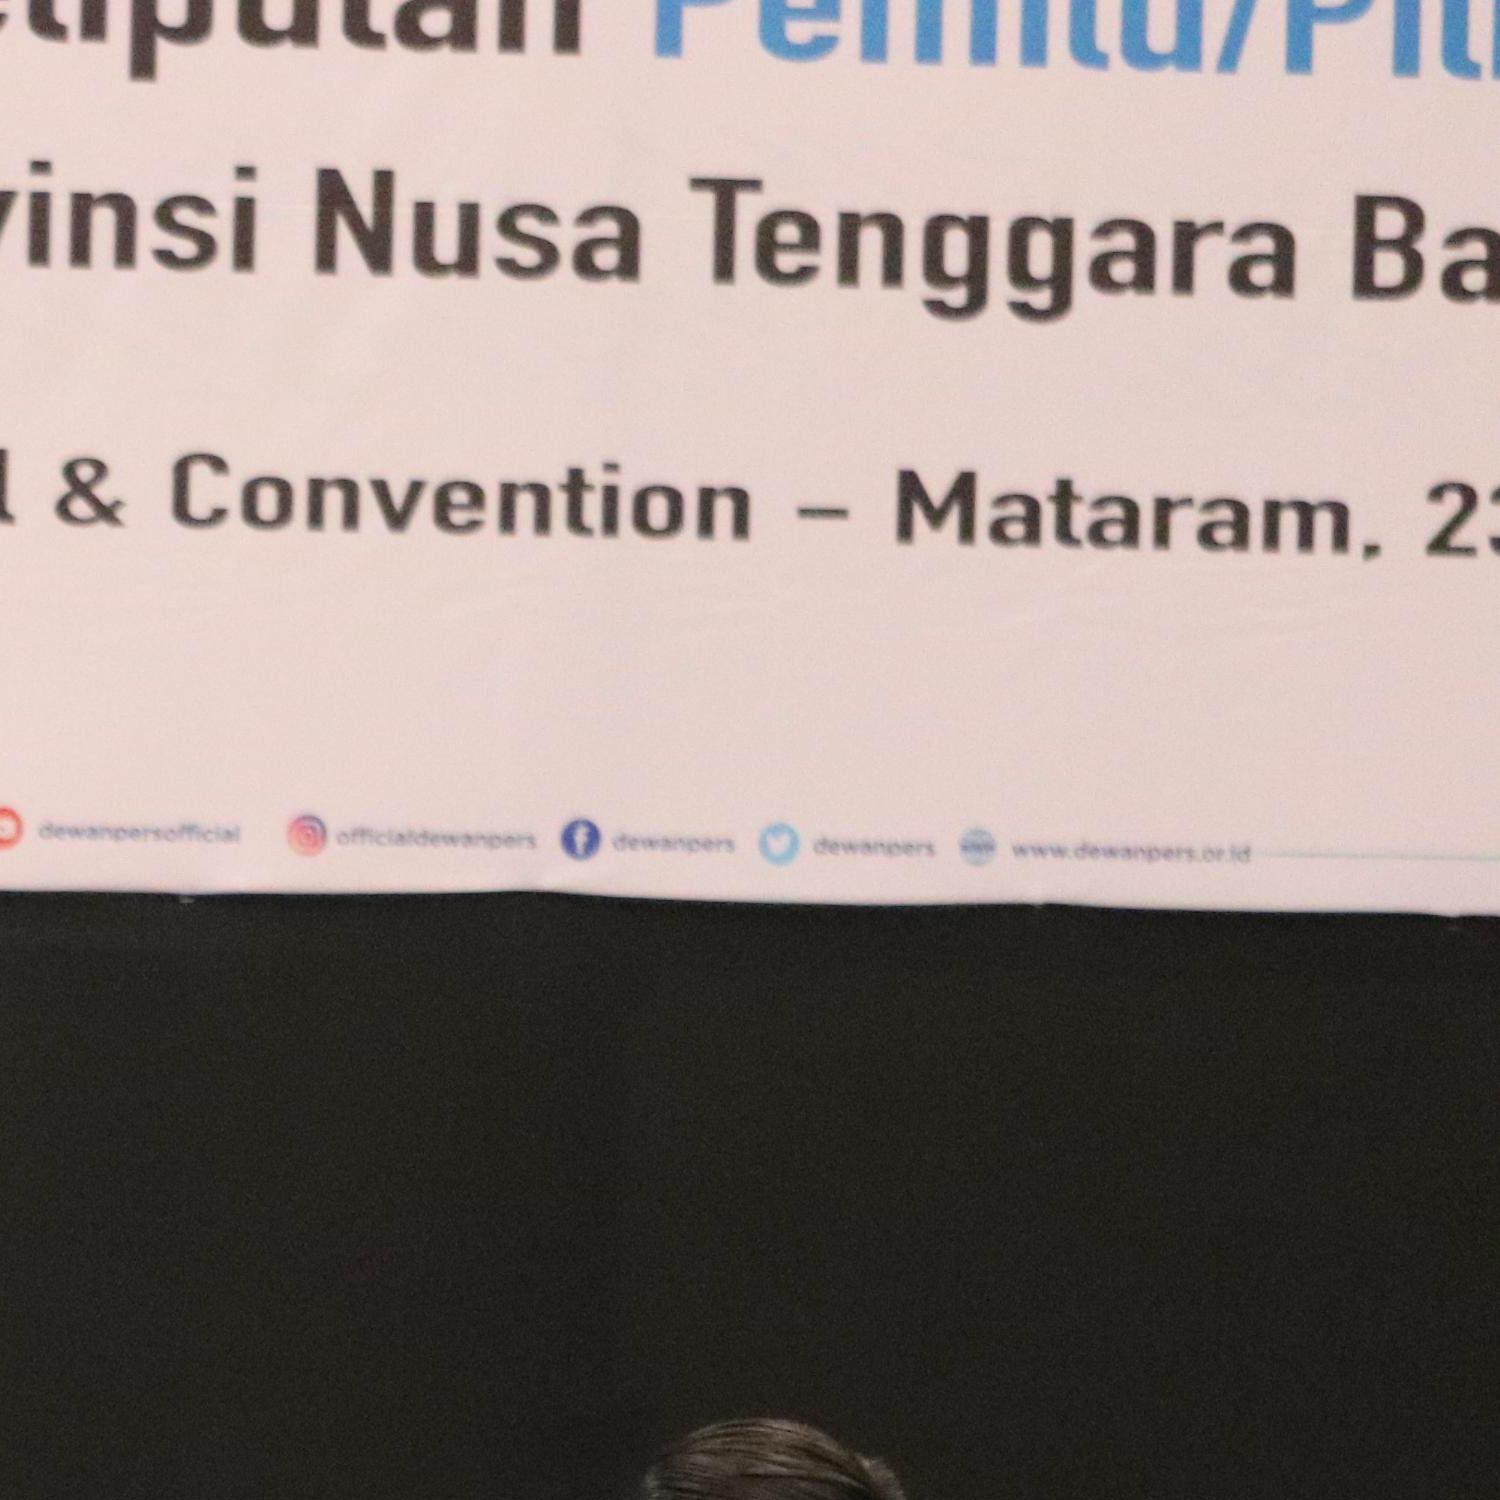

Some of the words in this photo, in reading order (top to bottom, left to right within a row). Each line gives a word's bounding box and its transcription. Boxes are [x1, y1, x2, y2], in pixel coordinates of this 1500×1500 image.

[314, 167, 642, 283] Nusa
[689, 176, 1297, 324] Tenggara
[1352, 193, 1500, 304] Ba
[54, 456, 124, 527] &
[171, 452, 751, 541] Convention
[1425, 480, 1500, 558] 2
[37, 820, 241, 847] dewanpersofficial
[336, 826, 538, 853] officialdewanpers
[611, 831, 736, 855] dewanpers
[812, 836, 937, 860] dewanpers
